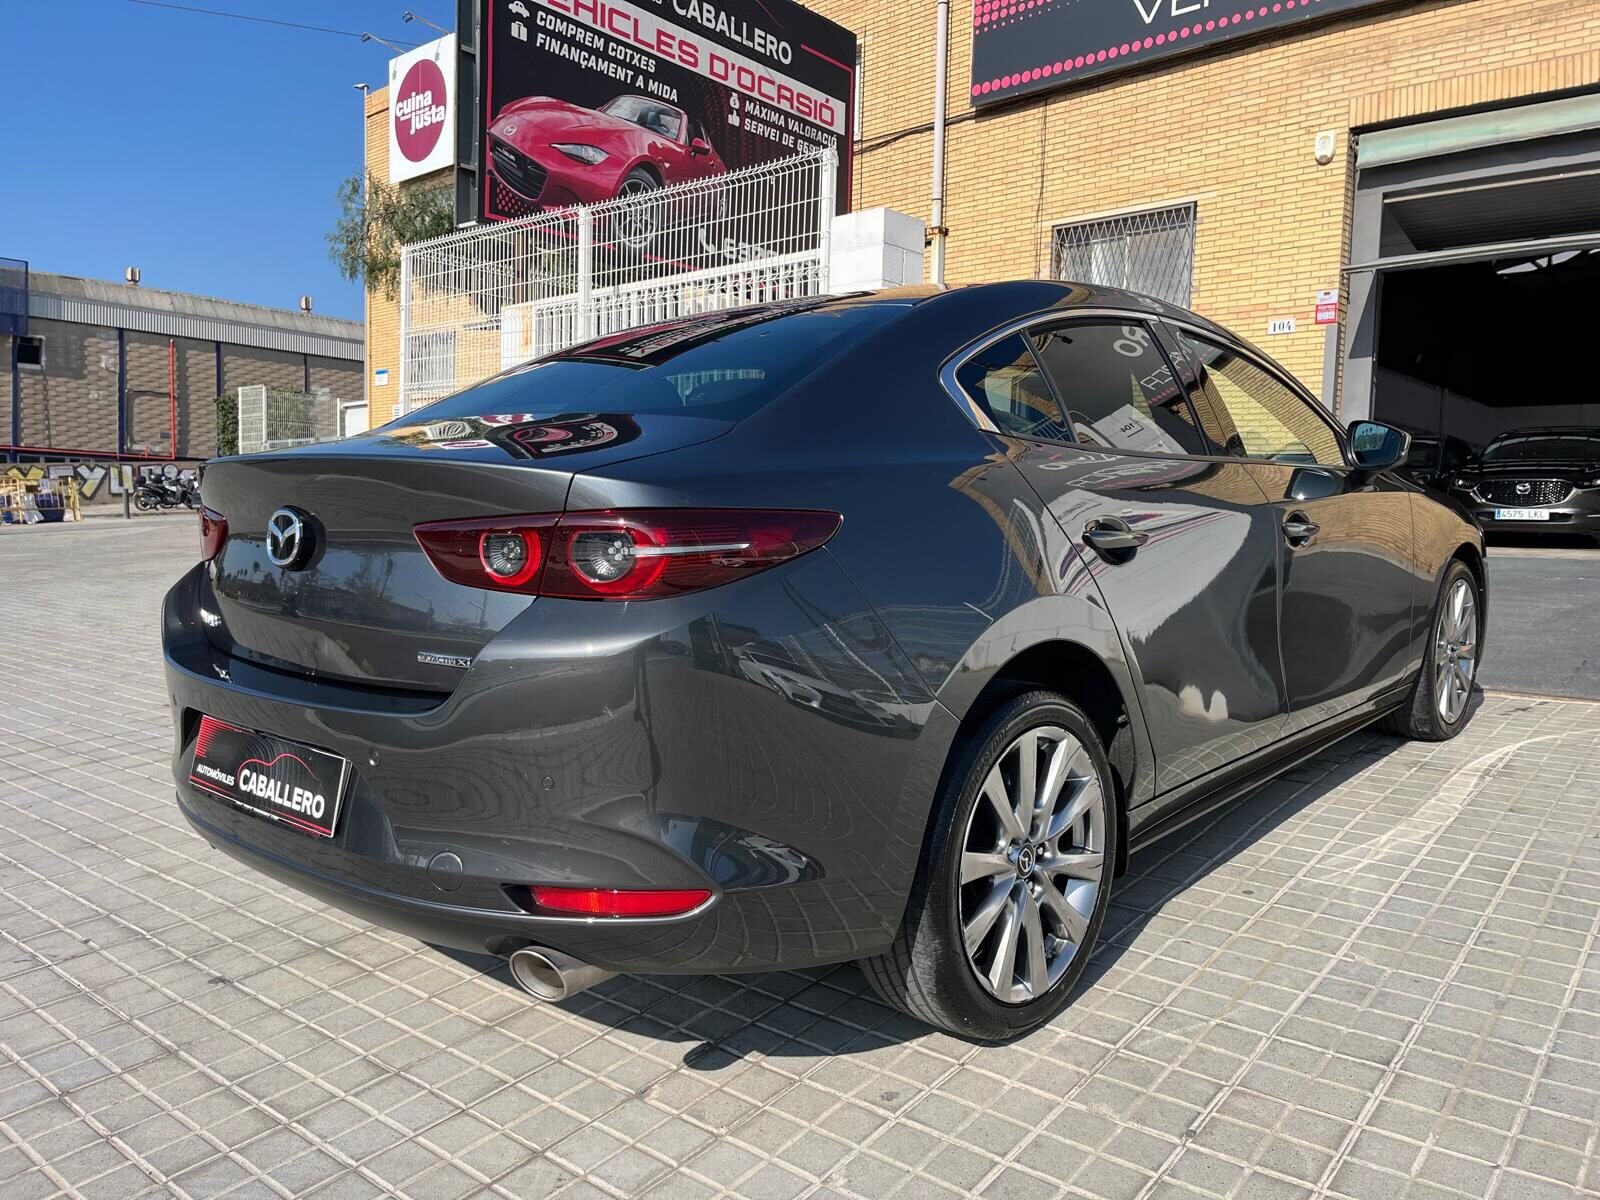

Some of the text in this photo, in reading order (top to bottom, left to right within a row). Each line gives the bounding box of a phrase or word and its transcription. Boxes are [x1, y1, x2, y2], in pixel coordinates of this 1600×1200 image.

[536, 11, 656, 73] COMPREM COTXES
[672, 0, 793, 65] CABALLERO
[536, 33, 678, 103] FINANÇAMENT A MIDA
[396, 90, 432, 117] cuina
[709, 53, 835, 128] D'OCASIÓ
[410, 104, 445, 135] justa
[745, 101, 785, 127] MÀXIMA
[744, 118, 780, 142] SERVEI
[782, 133, 794, 148] DE
[1273, 321, 1291, 332] 104
[1501, 510, 1524, 518] 4575
[196, 763, 325, 819] AUTOMÓVILES CABALLERO
